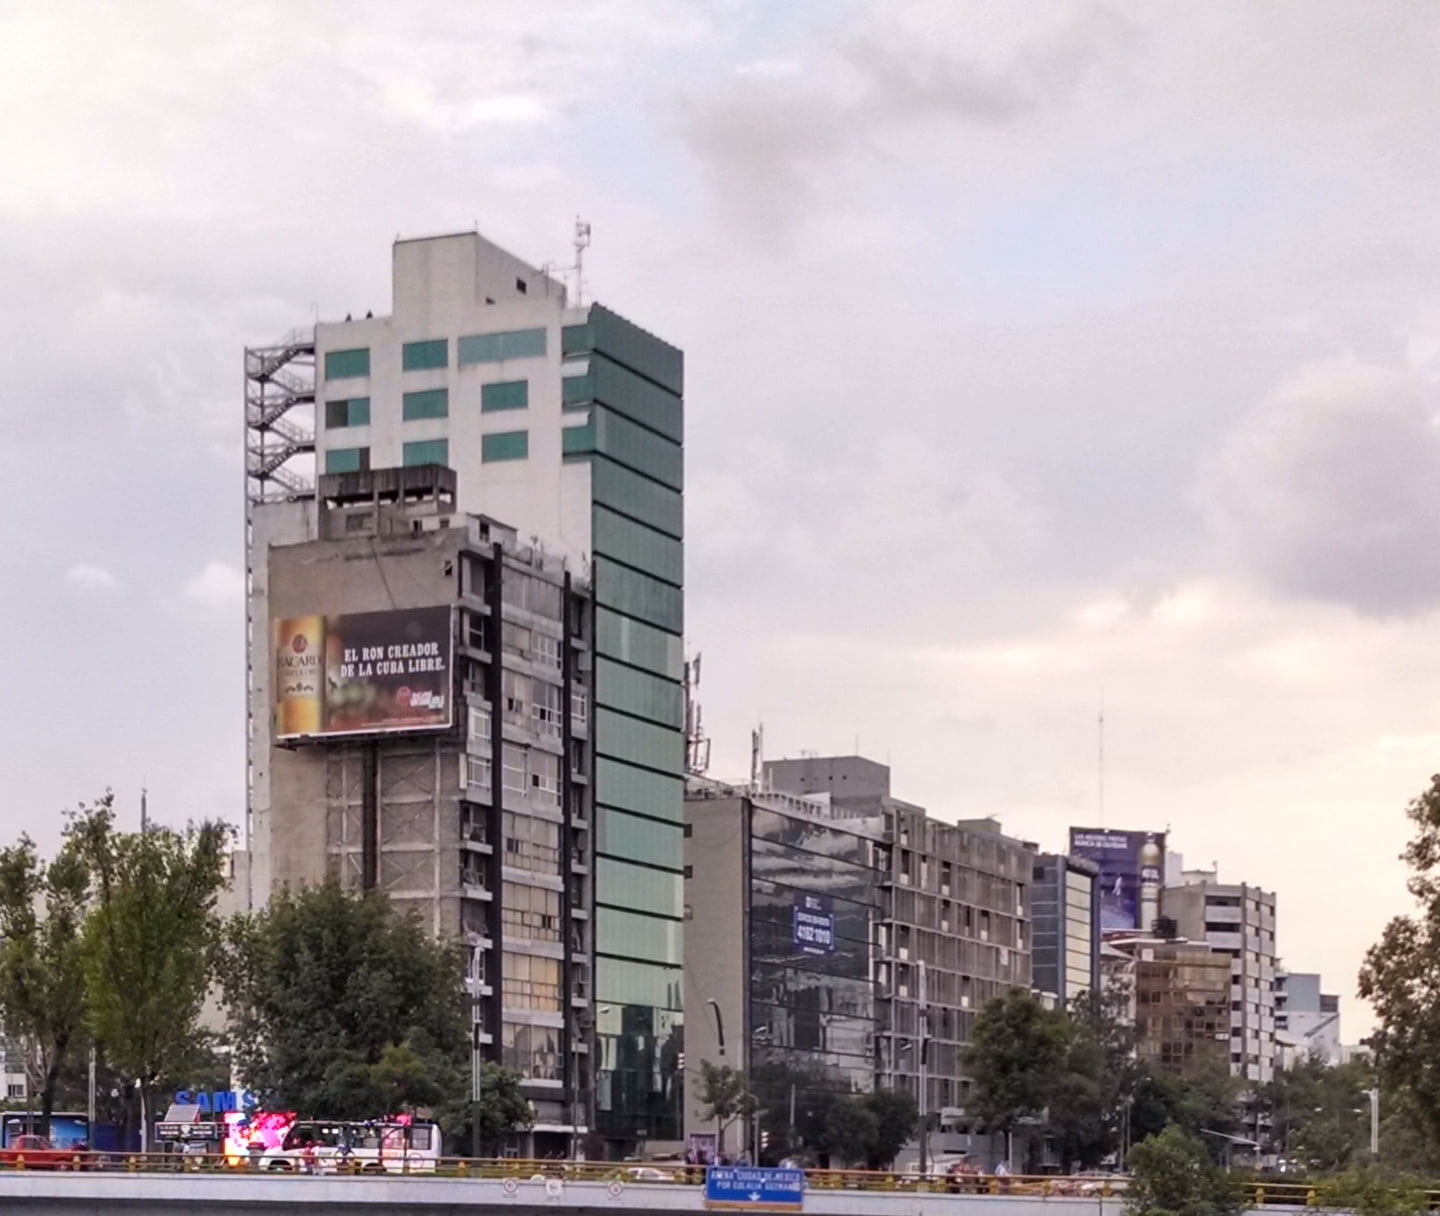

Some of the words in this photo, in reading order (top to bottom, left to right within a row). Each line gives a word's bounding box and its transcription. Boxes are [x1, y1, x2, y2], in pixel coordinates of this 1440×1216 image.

[345, 649, 358, 662] EL
[362, 647, 384, 661] RON
[388, 642, 438, 659] CREADOR
[341, 664, 355, 677] DE
[359, 663, 372, 676] LA
[376, 661, 404, 675] CUBA
[408, 657, 445, 672] LIBRE.
